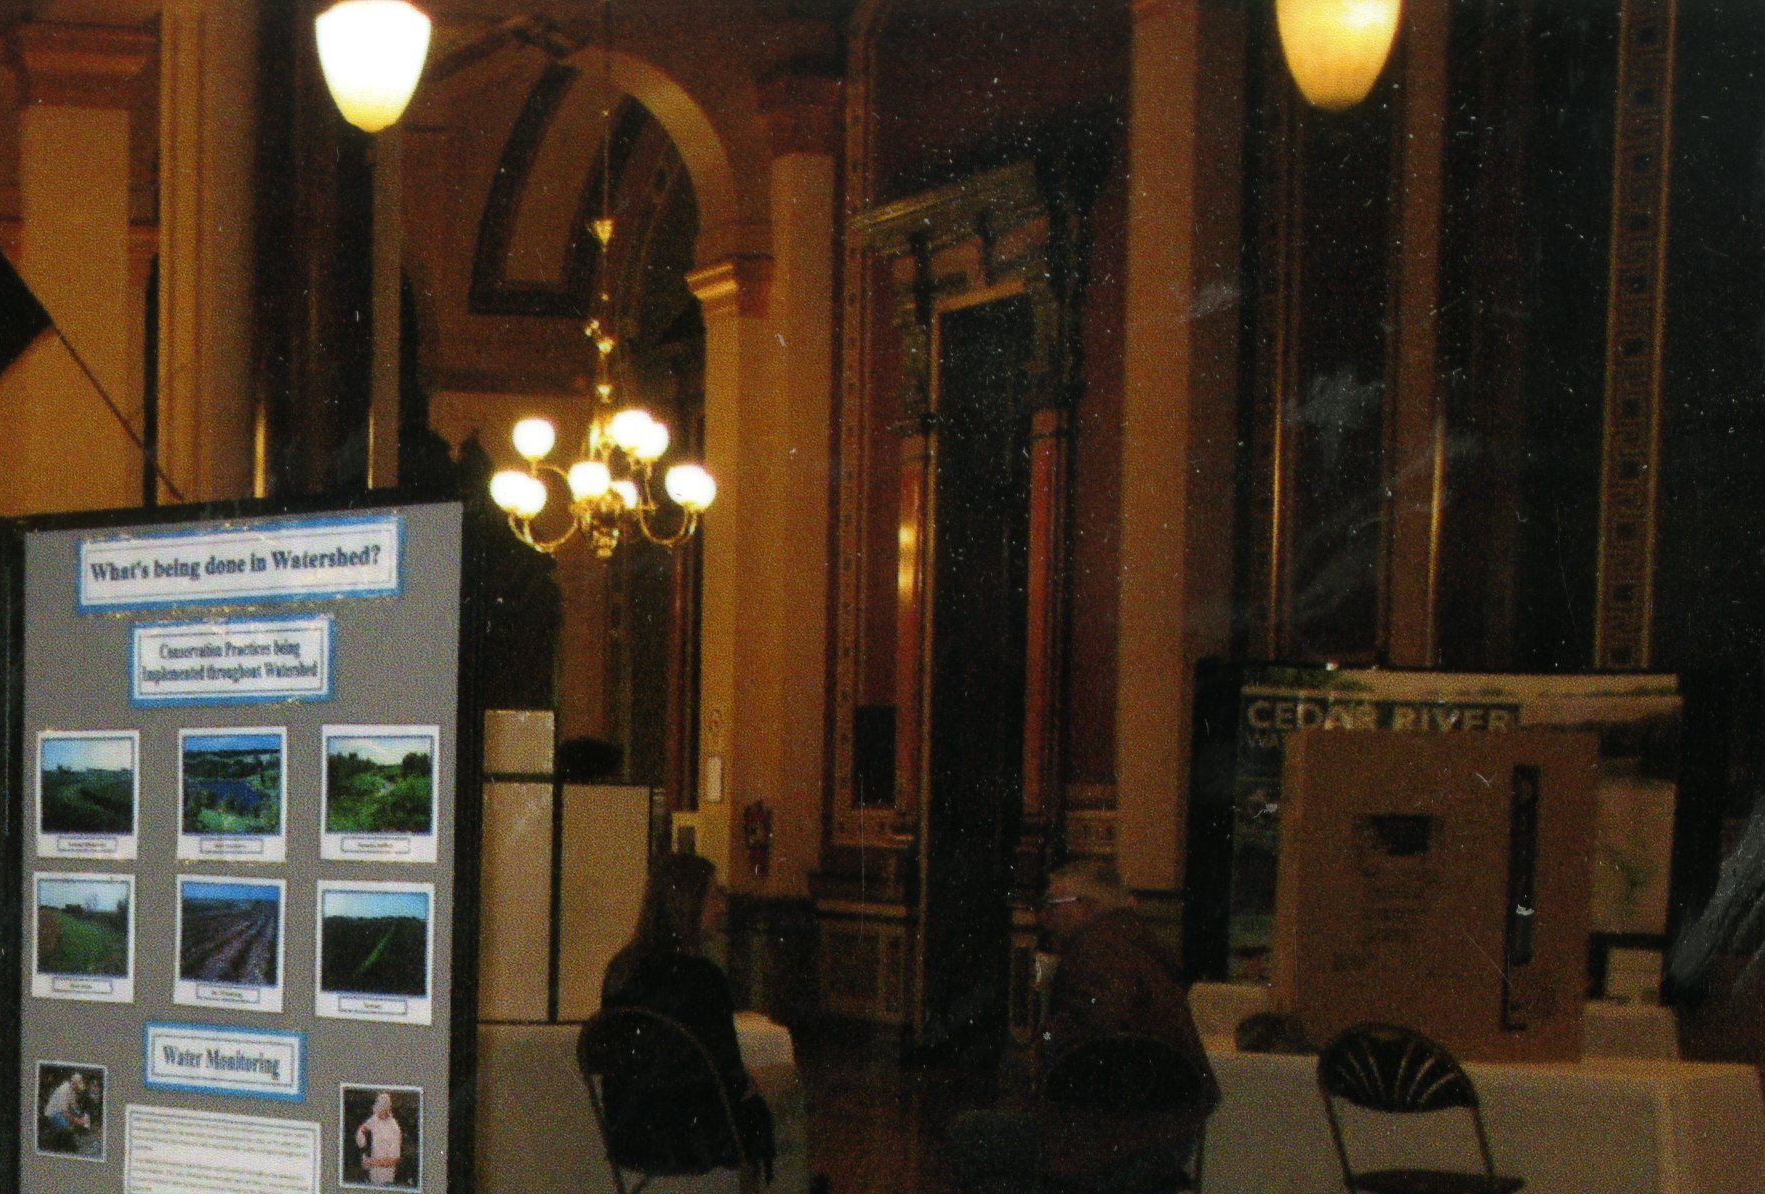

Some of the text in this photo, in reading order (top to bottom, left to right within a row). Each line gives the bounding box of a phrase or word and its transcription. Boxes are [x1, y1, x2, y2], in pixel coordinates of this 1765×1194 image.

[90, 545, 382, 582] What's being done in Watershed?
[1247, 700, 1512, 731] CEDAR RIVER
[162, 1045, 280, 1080] Water Monitoring
